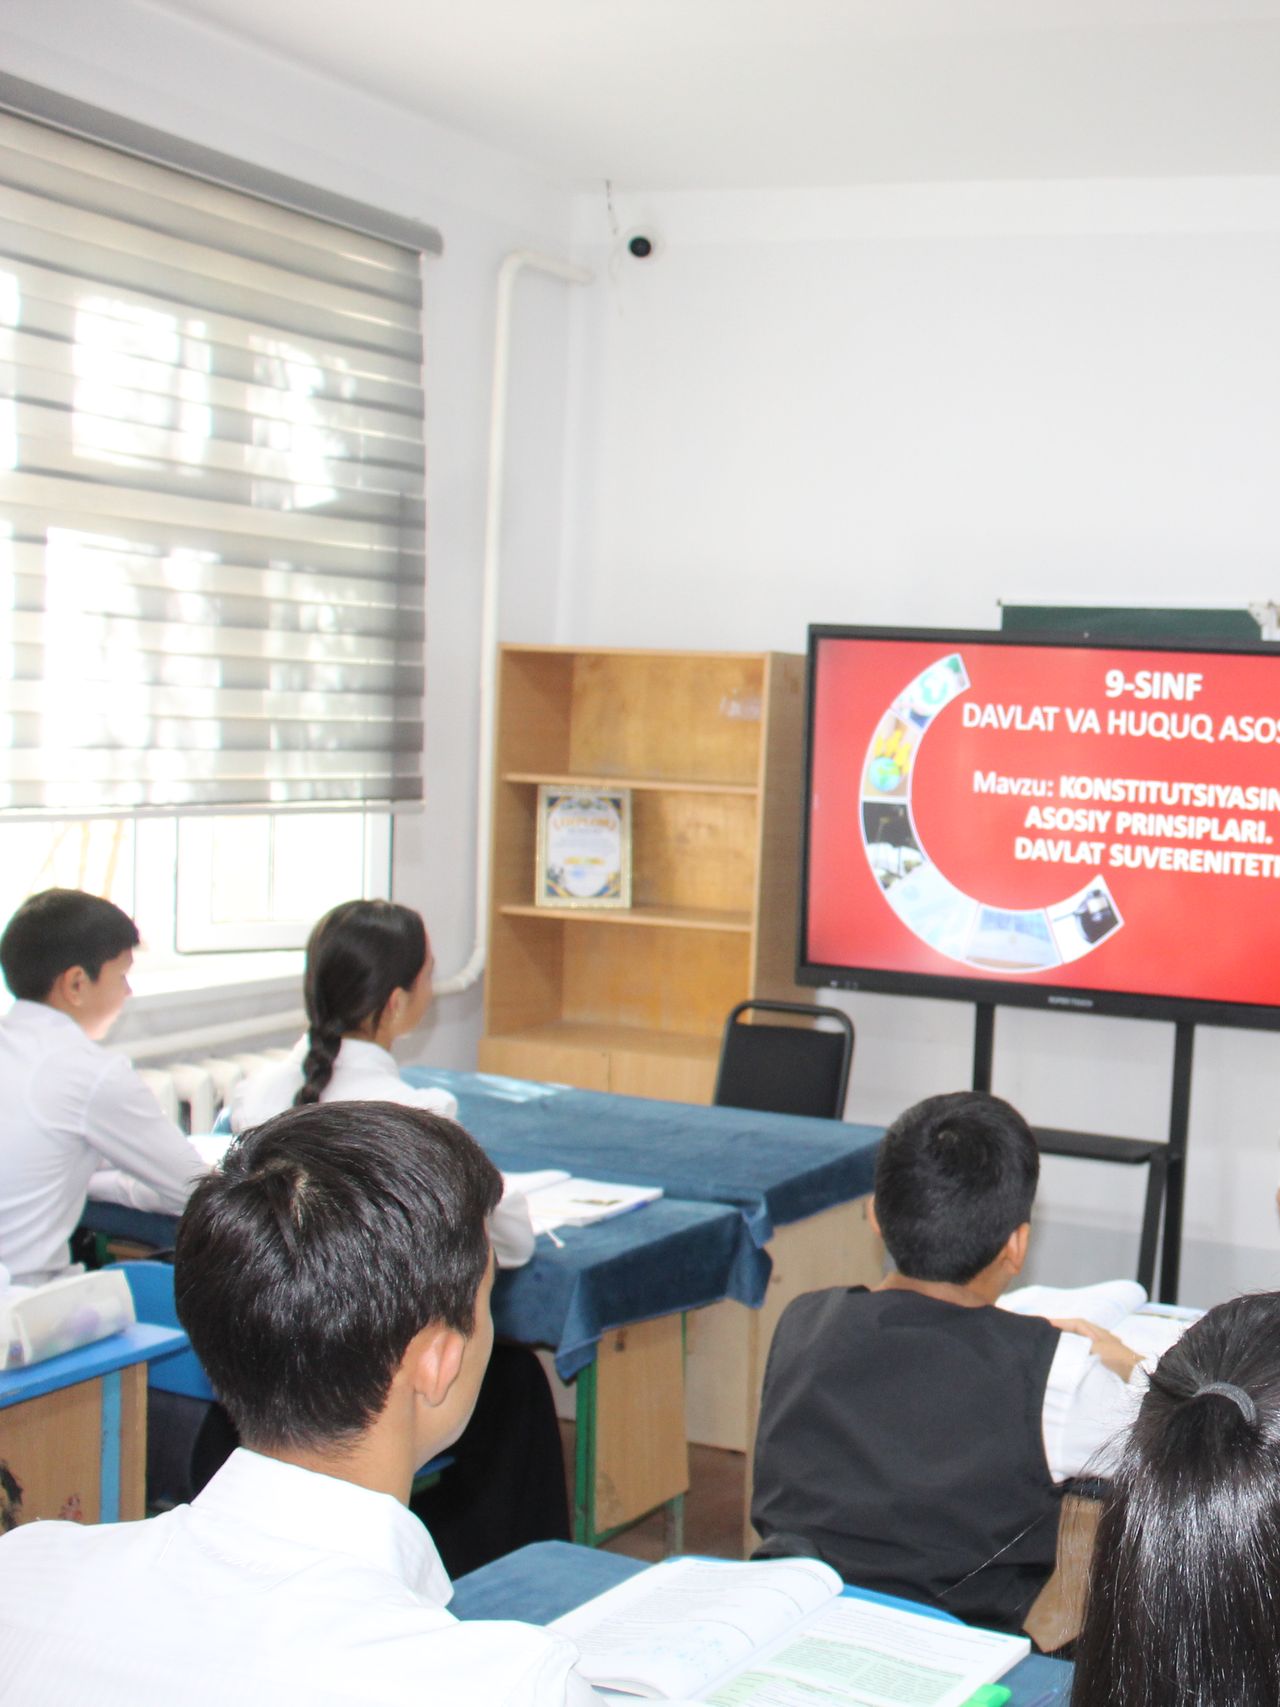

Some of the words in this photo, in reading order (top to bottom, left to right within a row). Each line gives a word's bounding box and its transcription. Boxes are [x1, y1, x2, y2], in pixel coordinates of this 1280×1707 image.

[1105, 669, 1203, 701] 9-SINF
[962, 703, 1060, 732] DAVLAT
[1065, 708, 1101, 734] VA
[1107, 709, 1215, 743] HUQUQ
[973, 770, 1054, 797] Mavzu:
[1024, 806, 1112, 833] ASOSIY
[1116, 811, 1274, 845] PRINSIPLARI.
[1014, 836, 1106, 865] DAVLAT
